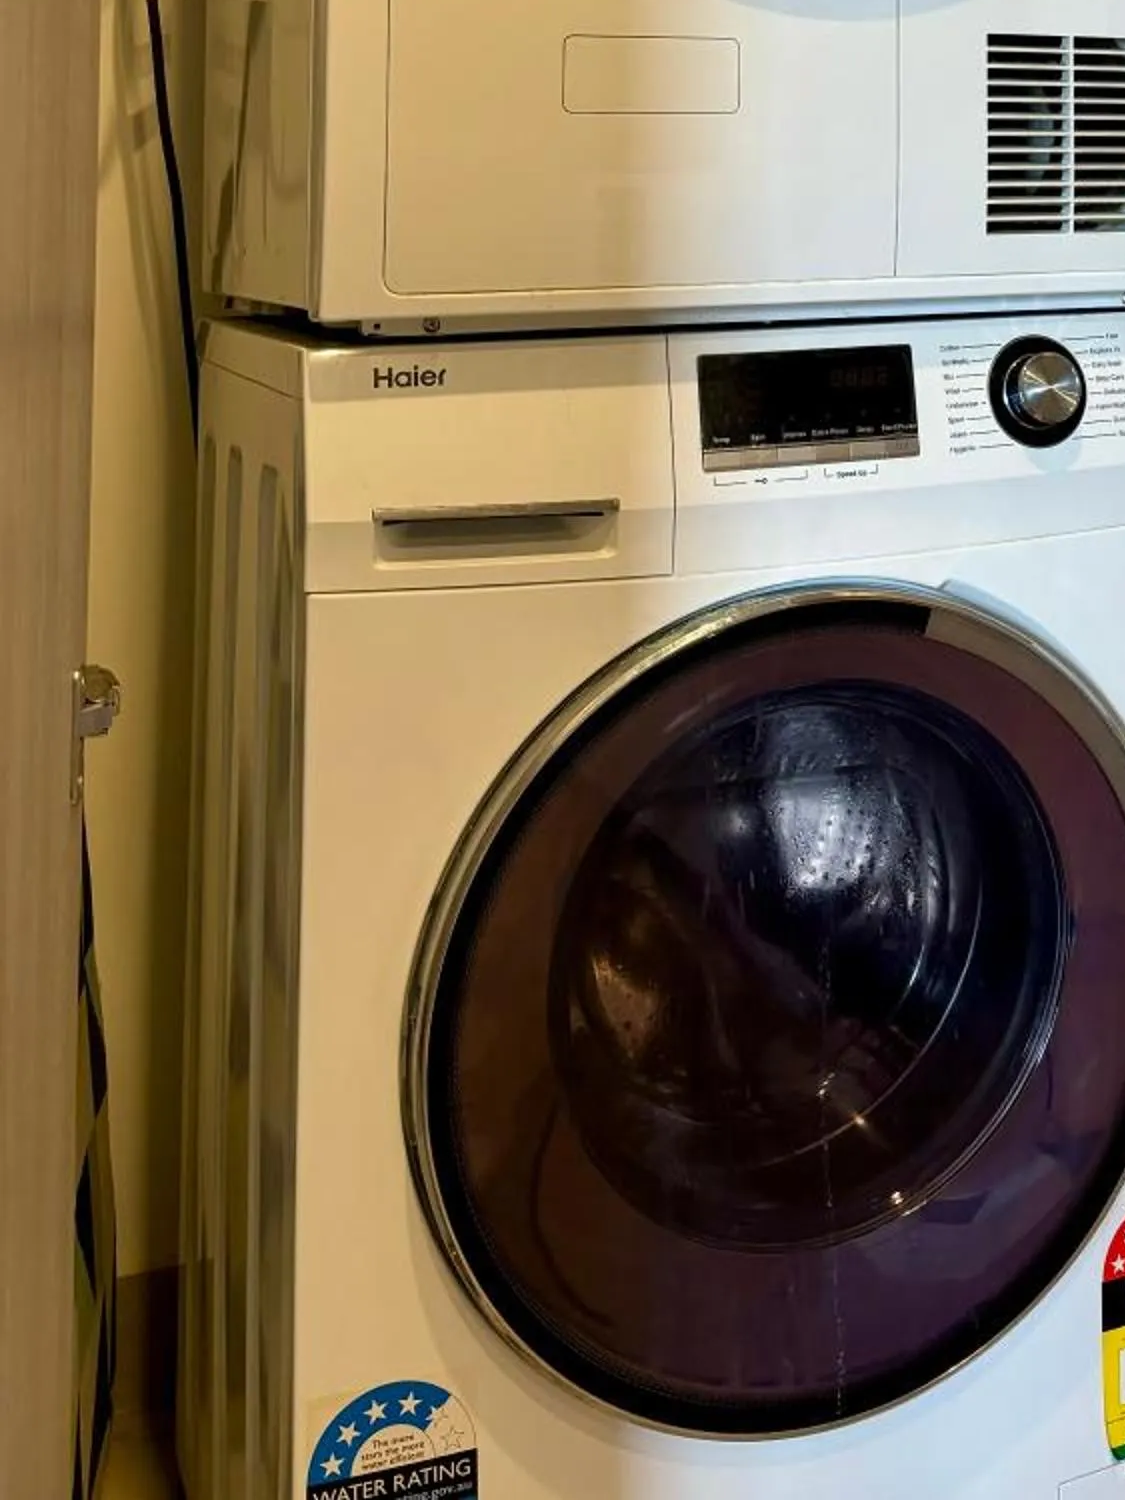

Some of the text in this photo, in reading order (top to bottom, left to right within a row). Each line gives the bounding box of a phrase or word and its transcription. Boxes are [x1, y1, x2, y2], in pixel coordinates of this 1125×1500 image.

[373, 364, 447, 389] Haier
[373, 1434, 415, 1449] The more
[385, 1447, 400, 1456] the
[402, 1441, 425, 1452] more
[393, 1457, 472, 1493] RATING
